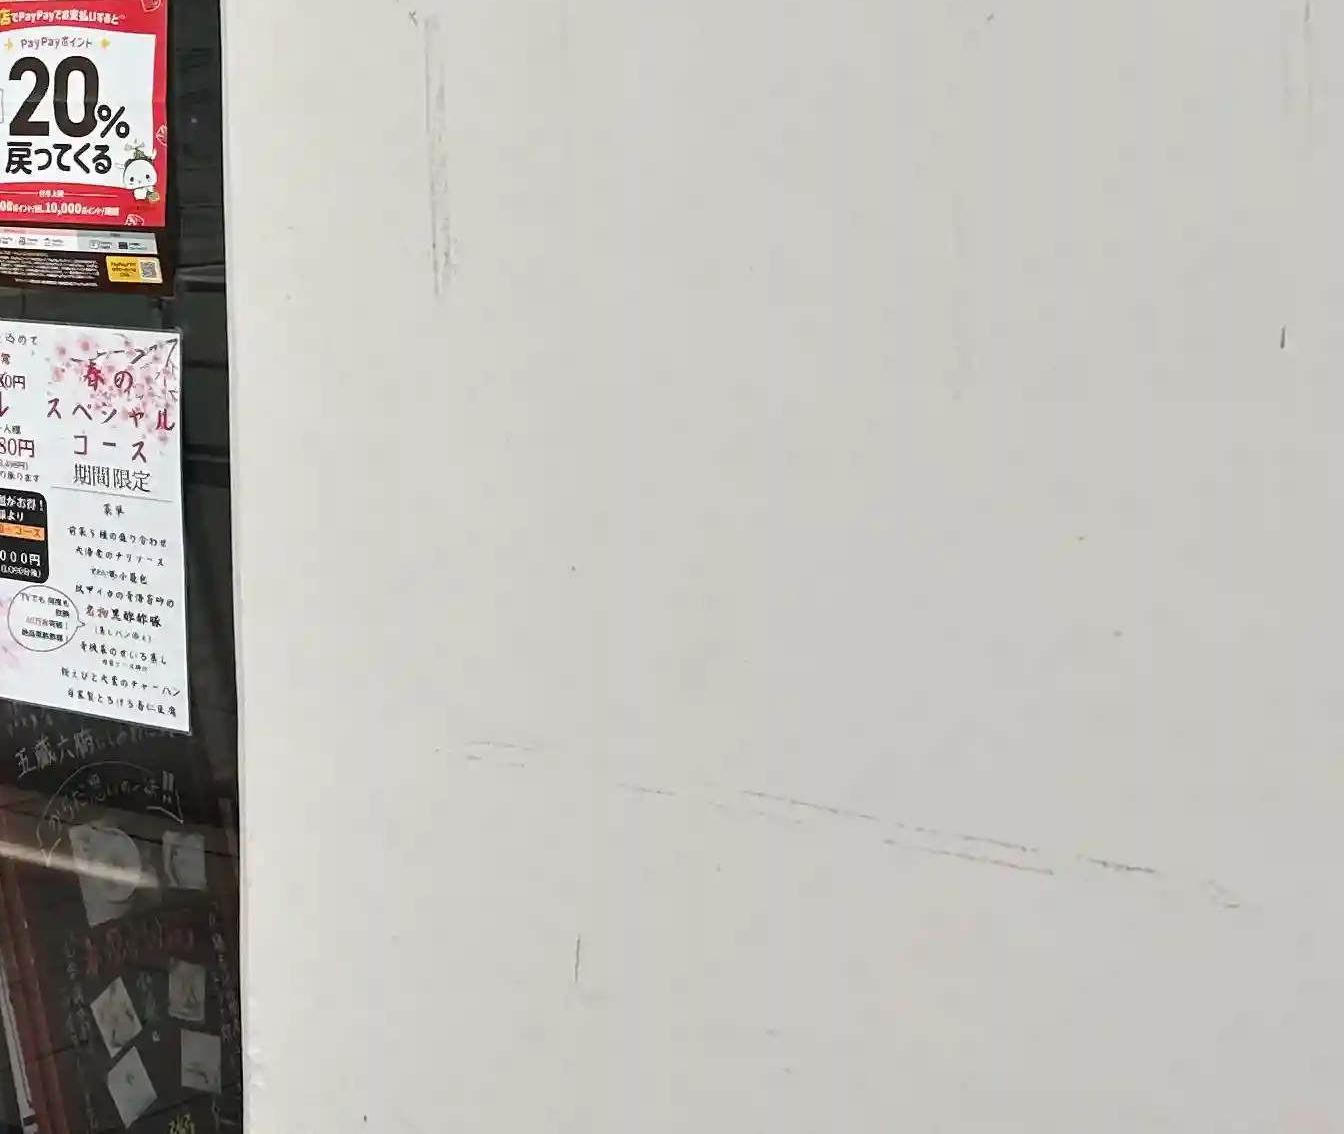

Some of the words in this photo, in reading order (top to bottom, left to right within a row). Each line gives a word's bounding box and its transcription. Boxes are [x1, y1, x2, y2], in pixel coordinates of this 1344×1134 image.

[20, 37, 93, 50] PayPayポイント
[8, 55, 130, 138] 20%
[5, 141, 112, 175] 戻ってくる
[85, 363, 134, 391] 春の
[46, 397, 176, 431] スペシャル
[73, 434, 148, 463] コース
[73, 463, 152, 494] 期間限定
